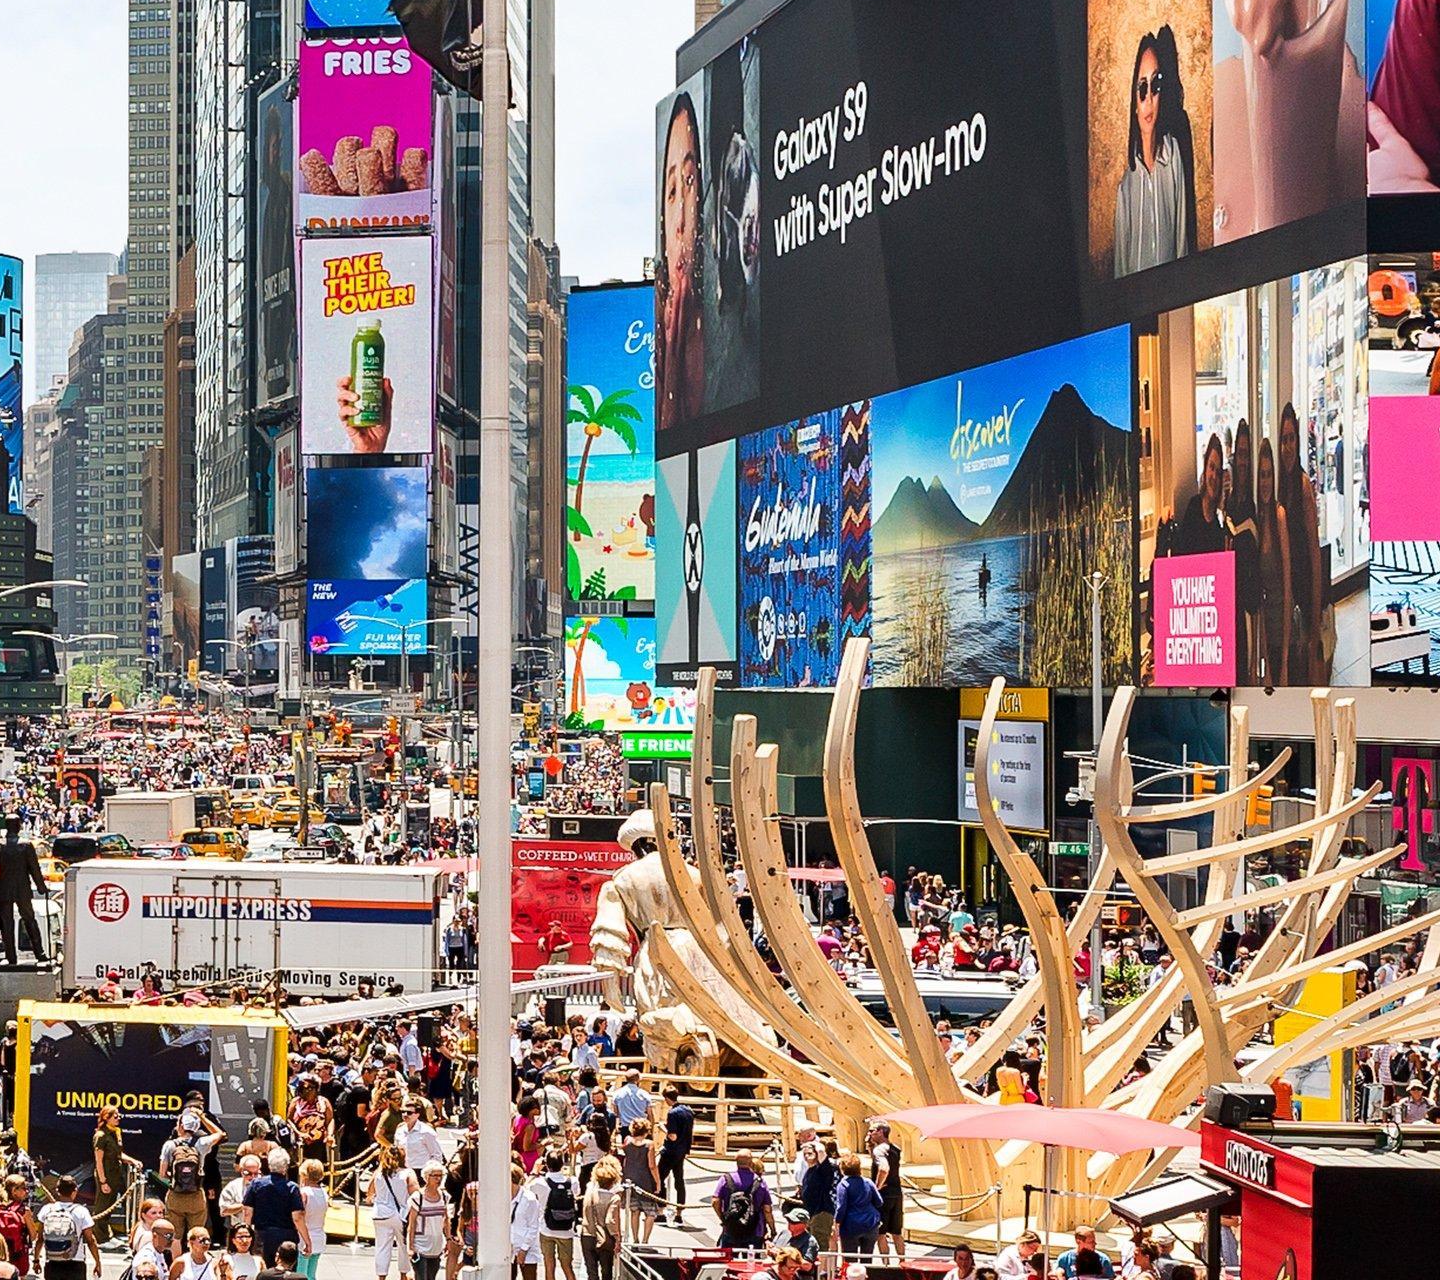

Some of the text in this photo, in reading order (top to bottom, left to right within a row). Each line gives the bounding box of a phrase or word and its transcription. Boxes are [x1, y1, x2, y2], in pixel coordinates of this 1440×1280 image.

[324, 49, 411, 76] FRIES
[774, 81, 868, 181] Galaxy S9
[774, 112, 987, 257] with Super Slow-mo
[324, 252, 383, 279] TAKE
[324, 271, 390, 297] THEIR
[325, 285, 415, 317] POWER!
[746, 476, 821, 553] Guatemala
[1171, 574, 1216, 606] YOU HAVE
[1168, 606, 1218, 635] UNLIMITED
[1165, 635, 1222, 666] EVERYTHING
[518, 850, 609, 862] COFFEED SWEET
[149, 897, 312, 922] NIPPON EXPRESS
[56, 1091, 183, 1111] UNMOORED
